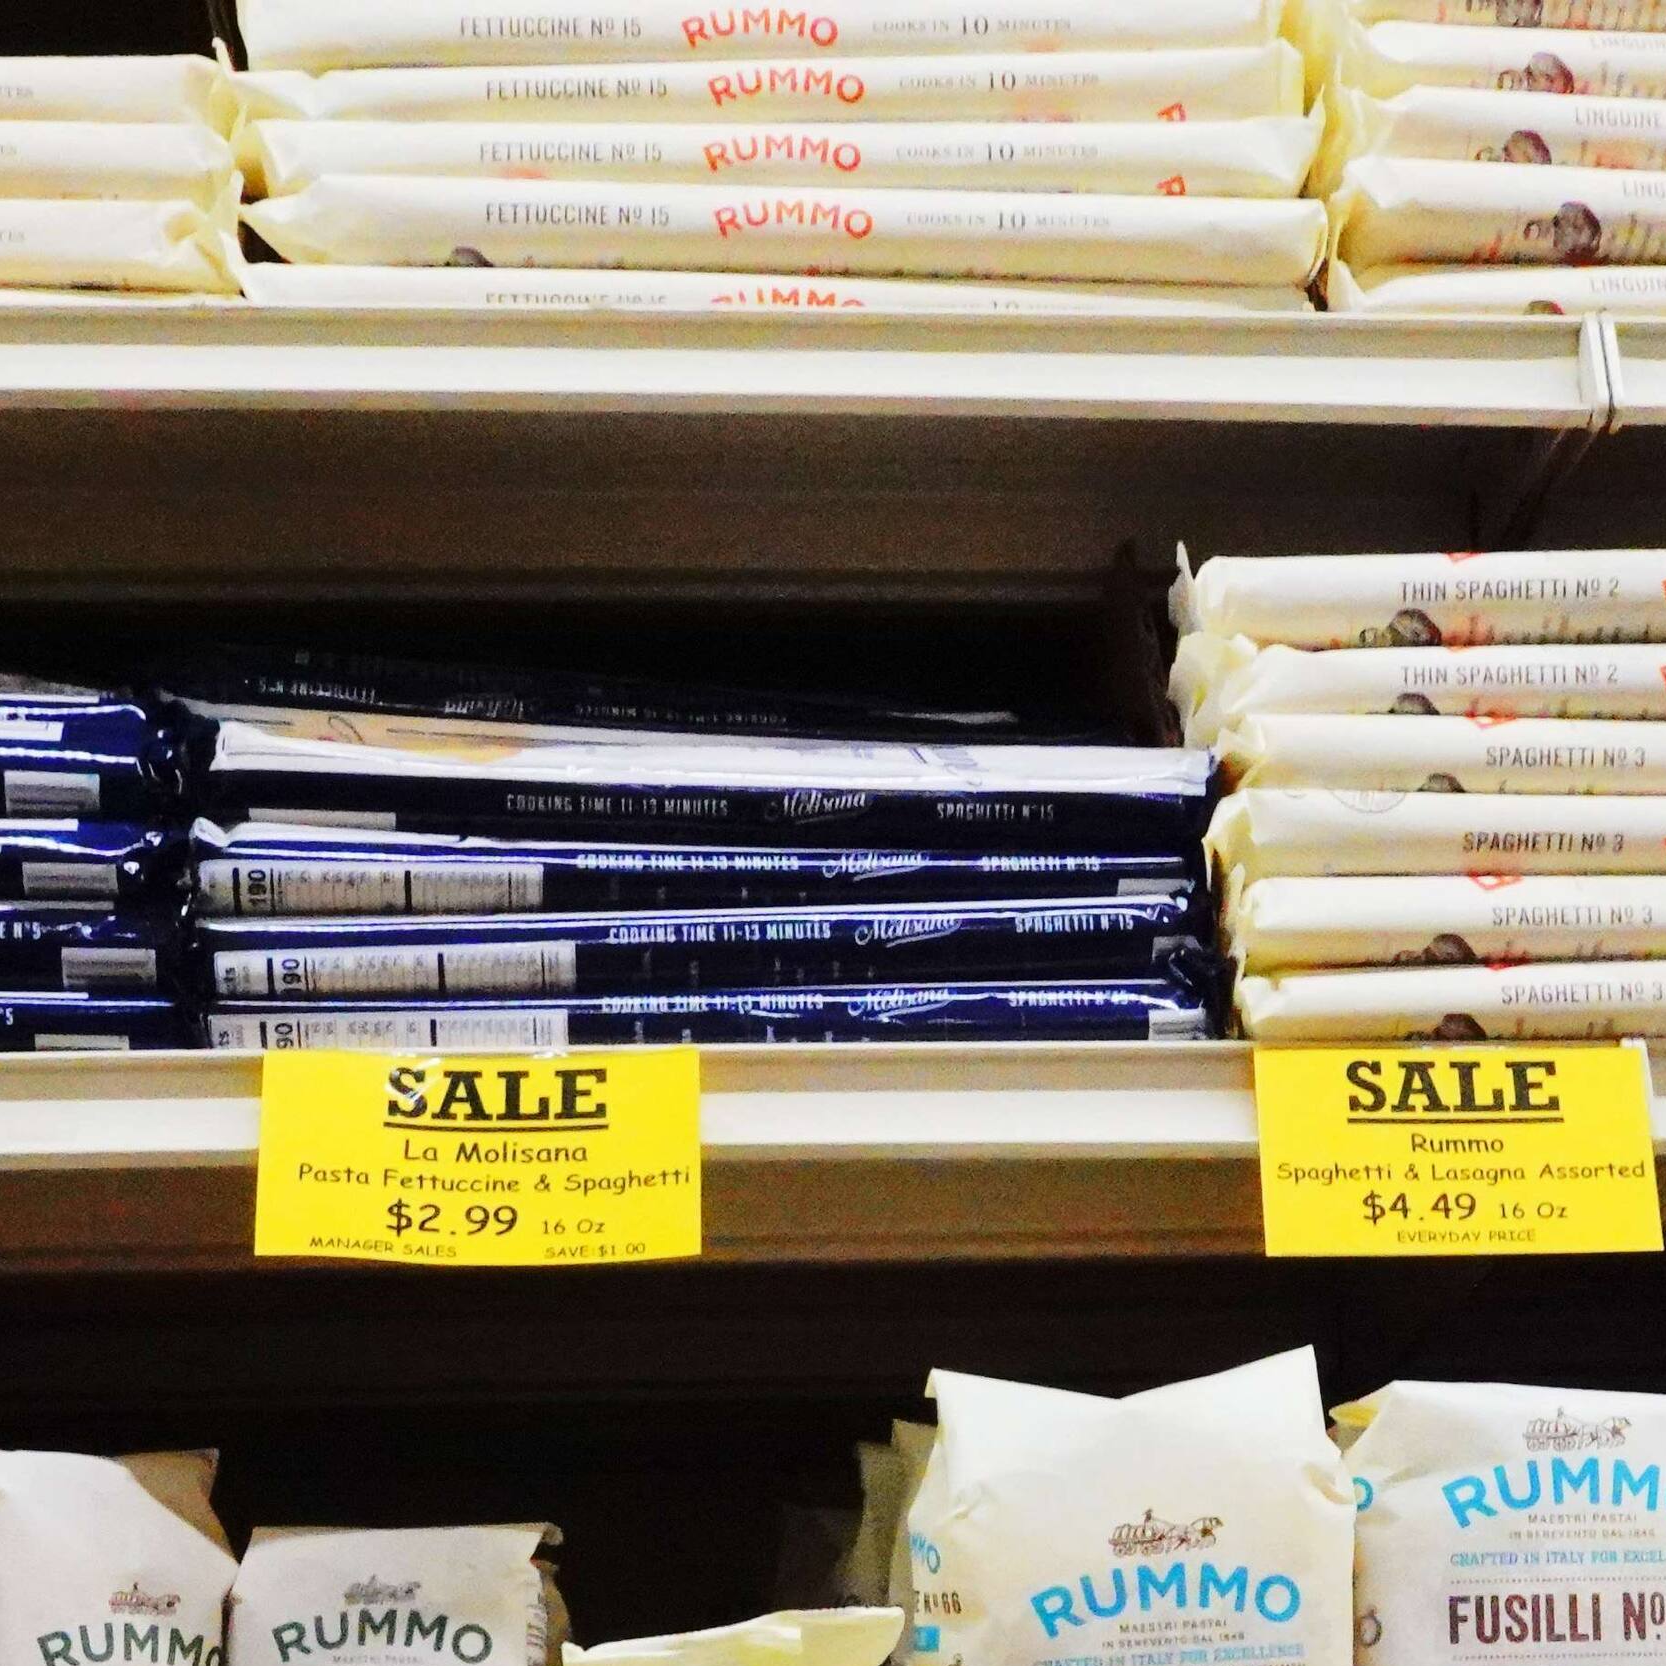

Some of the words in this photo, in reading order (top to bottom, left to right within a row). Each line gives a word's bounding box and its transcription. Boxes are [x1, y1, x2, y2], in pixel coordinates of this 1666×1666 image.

[485, 78, 608, 100] FETTUCCINE
[707, 66, 865, 106] RUMMO
[1401, 581, 1447, 601] THIN
[1455, 580, 1568, 600] SPAGHETTI
[1607, 578, 1620, 596] 2
[1486, 747, 1596, 766] SPAGHETTI
[609, 923, 677, 943] COOKING
[683, 923, 717, 941] TIME
[766, 921, 831, 940] MINUTES
[388, 1068, 608, 1122] SALE
[1346, 1060, 1561, 1113] SALE
[404, 1139, 438, 1163] La
[455, 1140, 588, 1164] Molisana
[1411, 1133, 1504, 1154] Rummo
[298, 1164, 369, 1187] Pasta
[383, 1168, 521, 1194] Fettuccine
[535, 1175, 552, 1193] &
[565, 1167, 691, 1196] Spaghetti
[1277, 1162, 1392, 1185] Spaghetti
[1405, 1164, 1420, 1182] &
[1431, 1163, 1526, 1185] Lasagna
[1539, 1162, 1645, 1180] Assorted
[386, 1198, 518, 1237] $2.99
[541, 1218, 564, 1235] 16
[576, 1218, 605, 1235] Oz
[1363, 1190, 1477, 1226] $4.49
[1500, 1203, 1525, 1219] 16
[1537, 1202, 1568, 1219] Oz
[309, 1236, 395, 1255] MANAGER
[403, 1243, 458, 1257] SALES
[1397, 1230, 1481, 1244] EVERYDAY
[1489, 1228, 1536, 1242] PRICE
[1030, 1561, 1301, 1640] RUMMO
[1449, 1592, 1602, 1646] FUSILLI
[271, 1608, 494, 1665] RUMMO
